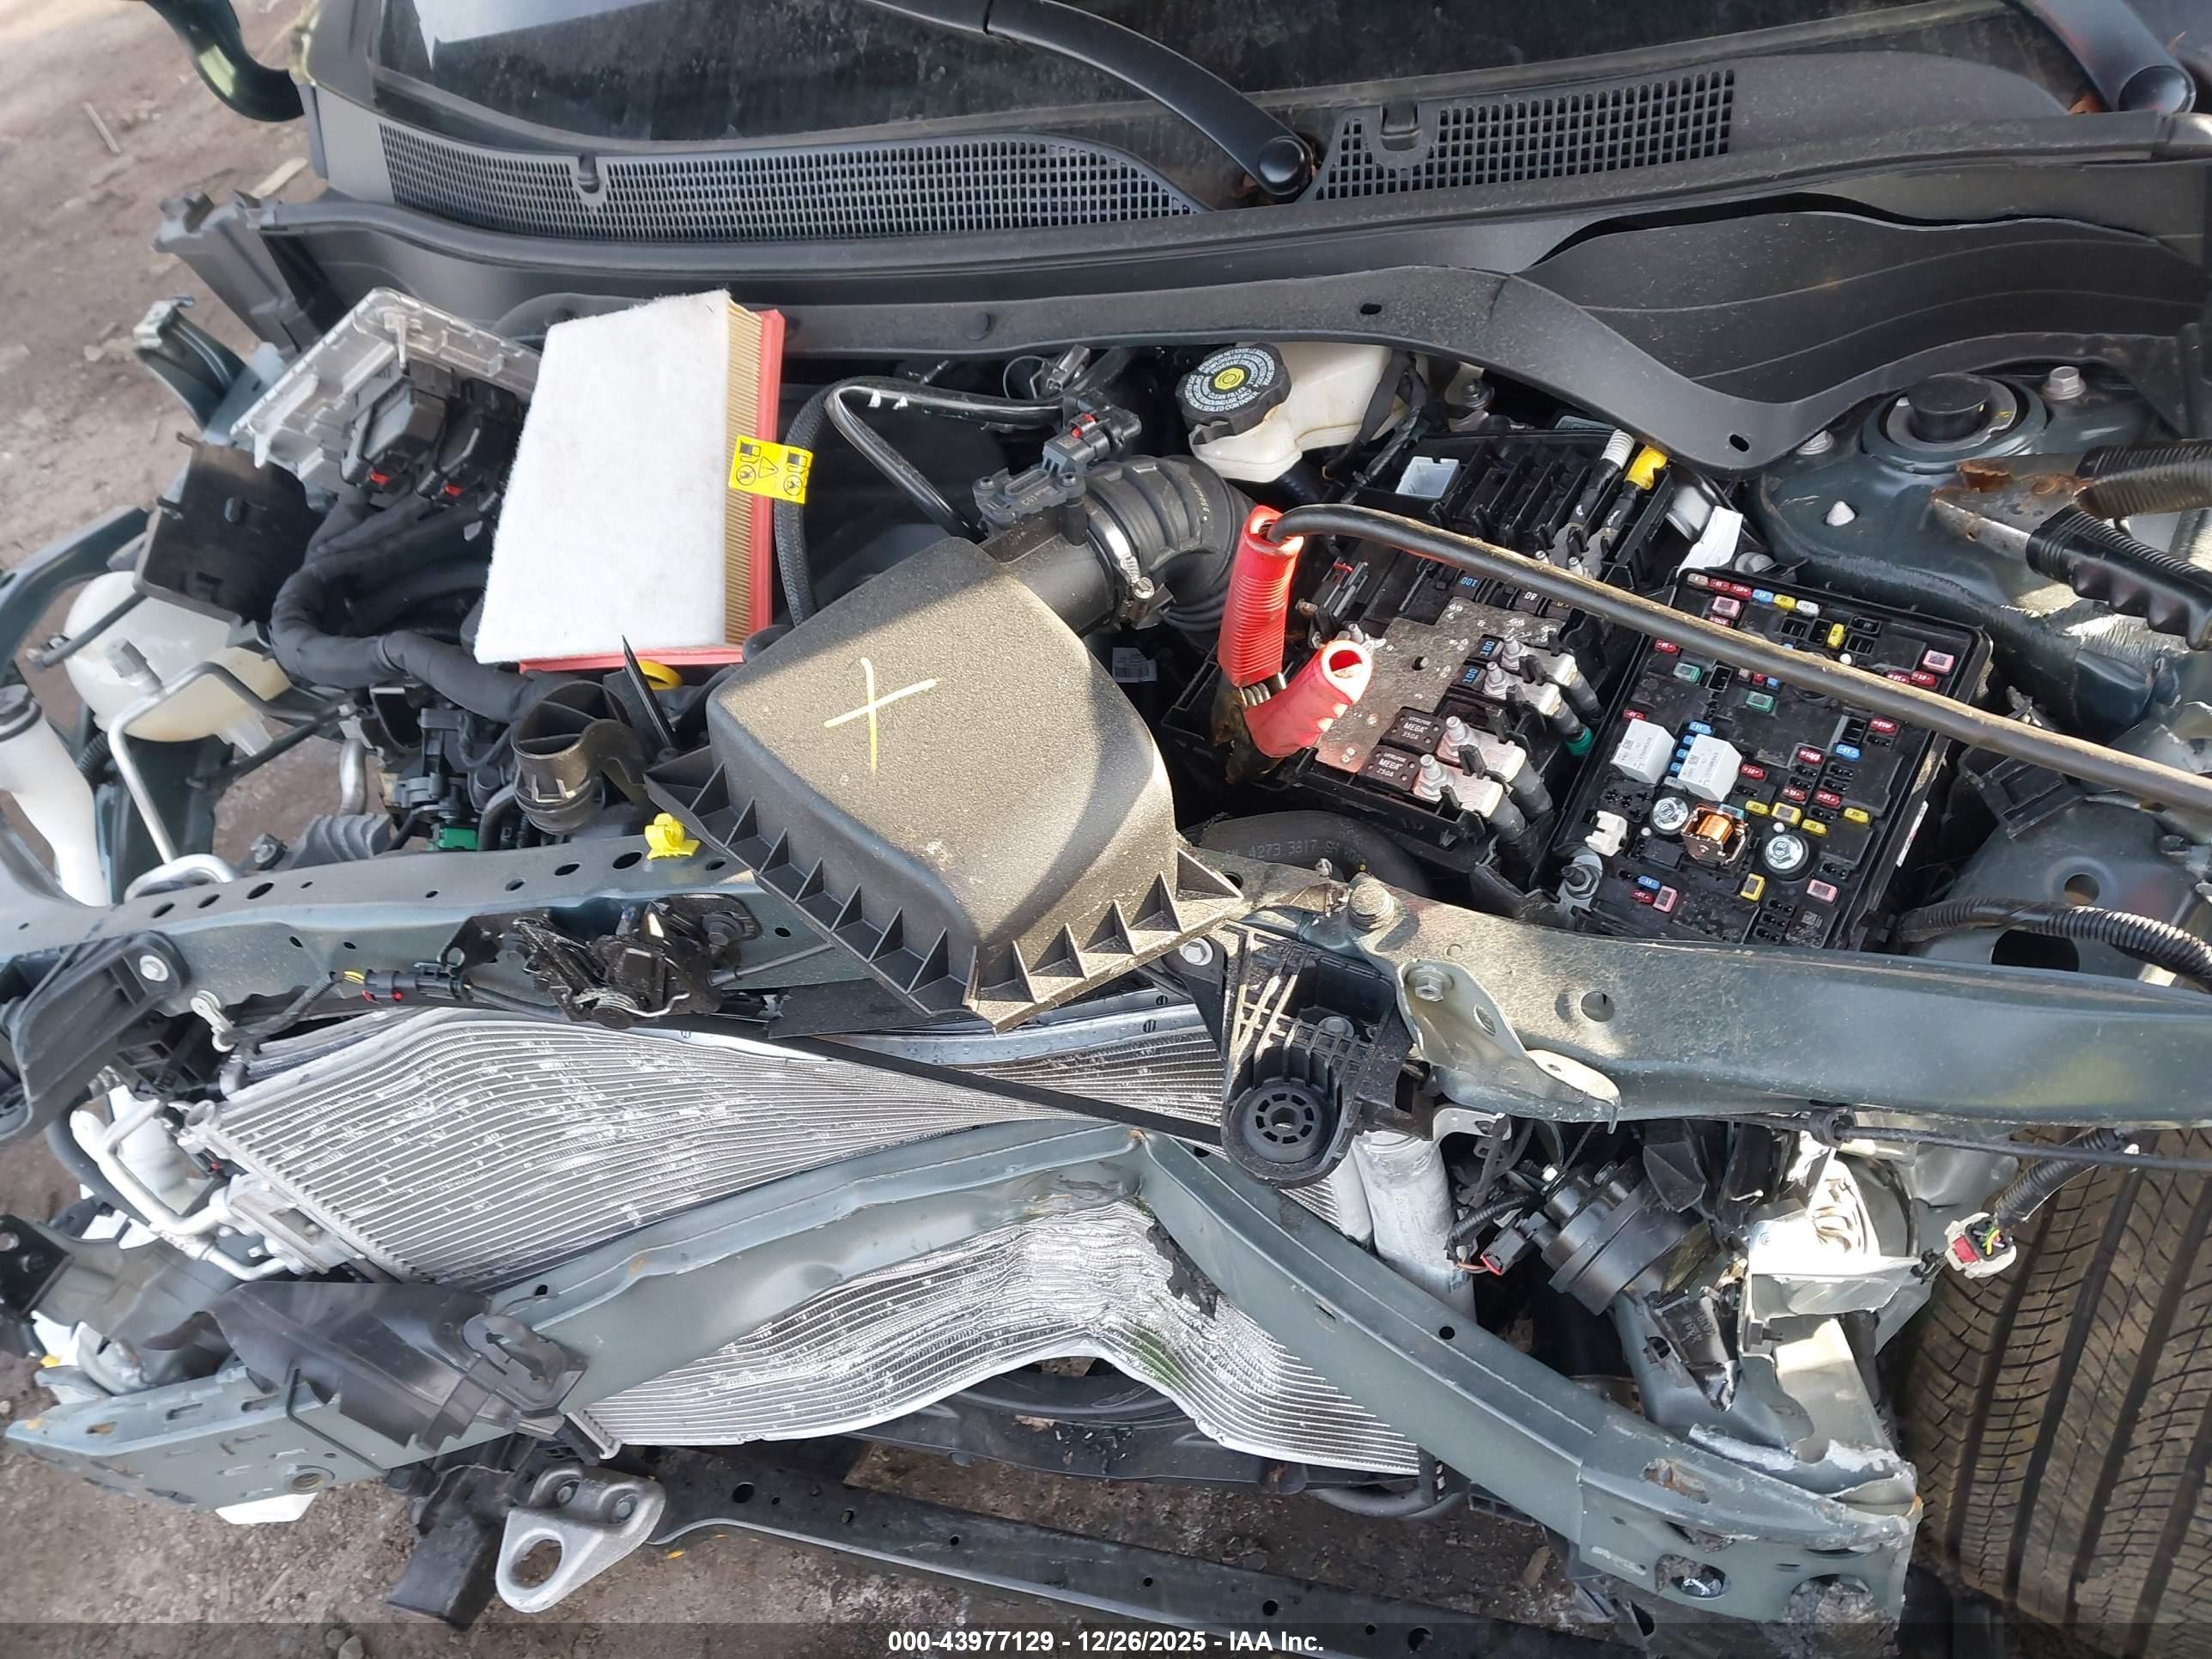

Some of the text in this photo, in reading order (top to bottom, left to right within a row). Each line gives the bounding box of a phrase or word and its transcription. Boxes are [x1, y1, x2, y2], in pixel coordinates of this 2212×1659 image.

[1460, 576, 1478, 587] 100
[1480, 641, 1495, 656] 100
[1462, 668, 1478, 684] 100
[1403, 722, 1426, 733] MEGA
[1401, 731, 1419, 740] 350A
[1378, 758, 1402, 769] MEGA
[1376, 768, 1395, 777] 250A
[1249, 843, 1280, 859] 4273
